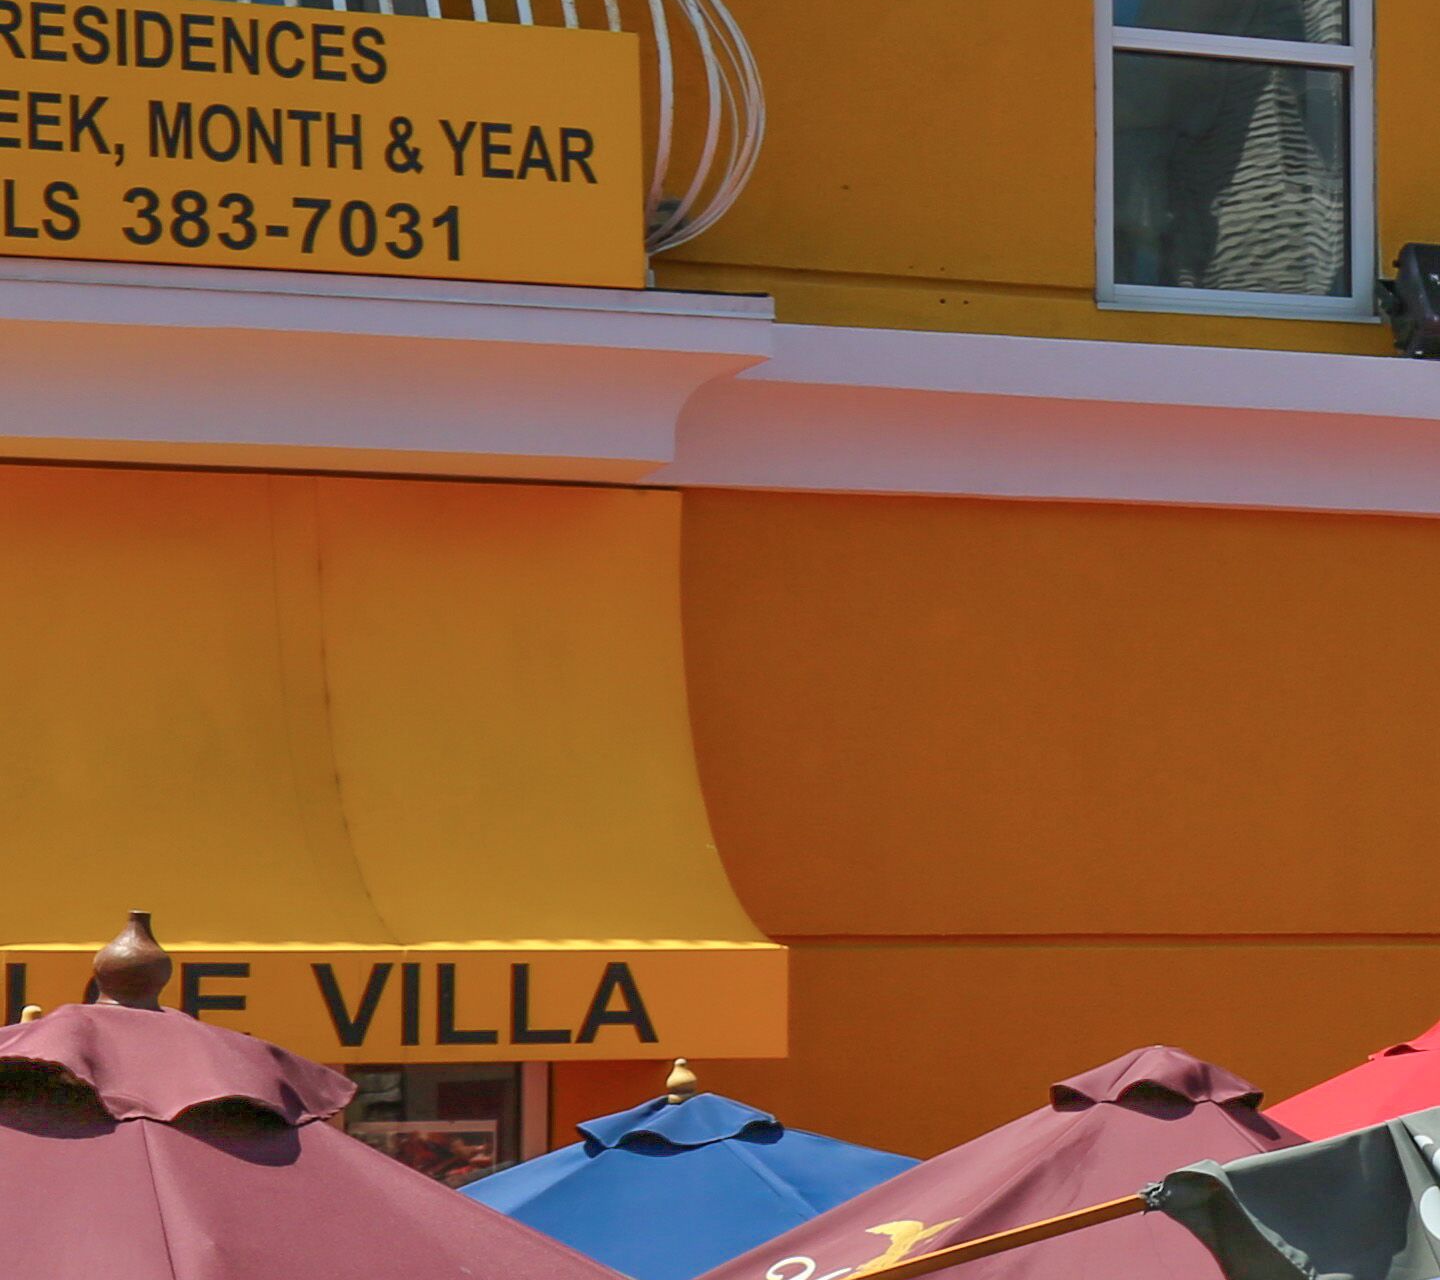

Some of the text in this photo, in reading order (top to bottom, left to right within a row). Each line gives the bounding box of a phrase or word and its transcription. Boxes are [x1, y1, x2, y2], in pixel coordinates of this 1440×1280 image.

[0, 0, 389, 84] RESIDENCES
[148, 100, 364, 172] MONTH
[385, 116, 424, 175] &
[439, 119, 598, 185] YEAR
[4, 179, 462, 262] LS 383-7031
[311, 960, 659, 1048] VILLA
